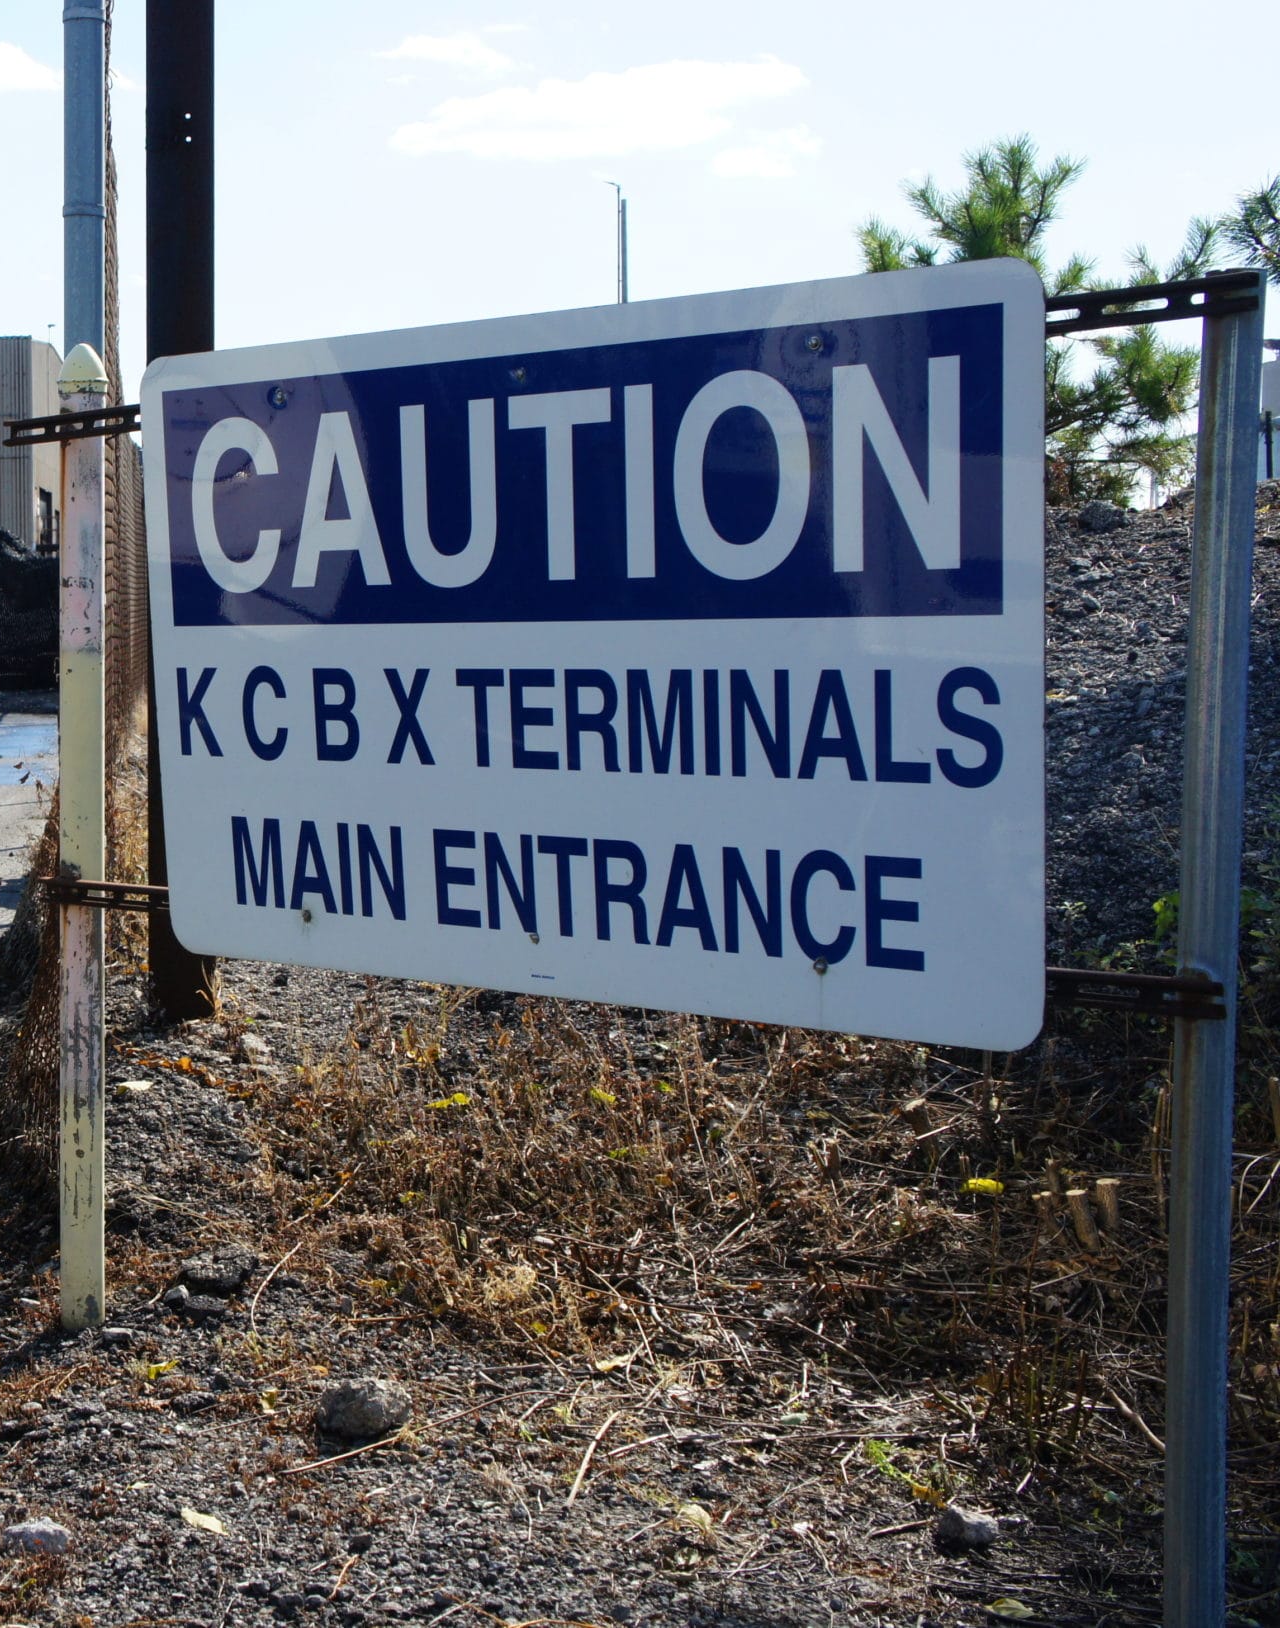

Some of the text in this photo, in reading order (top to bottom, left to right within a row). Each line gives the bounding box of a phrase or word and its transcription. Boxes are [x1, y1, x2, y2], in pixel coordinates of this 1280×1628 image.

[191, 355, 961, 594] CAUTION
[455, 666, 1004, 789] TERMINALS
[231, 815, 925, 972] MAIN ENTRANCE
